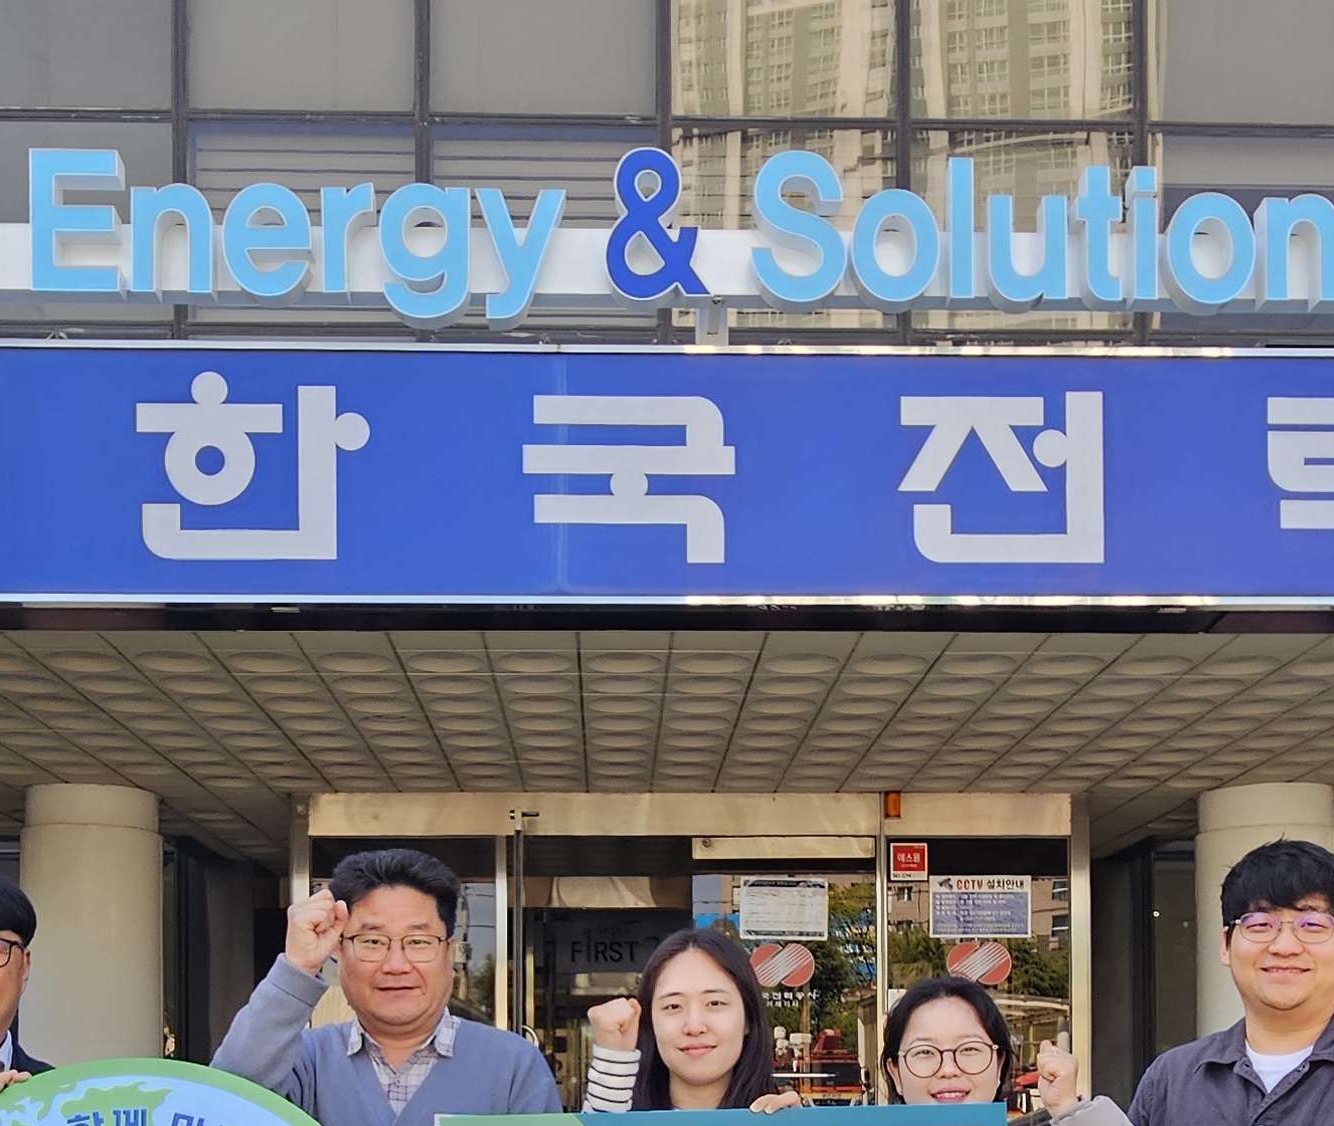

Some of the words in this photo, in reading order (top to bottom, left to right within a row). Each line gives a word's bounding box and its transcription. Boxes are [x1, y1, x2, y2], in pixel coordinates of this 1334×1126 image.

[28, 147, 565, 321] Energy
[605, 147, 711, 302] &
[956, 880, 983, 890] CCTV
[986, 879, 1024, 890] 설치안내
